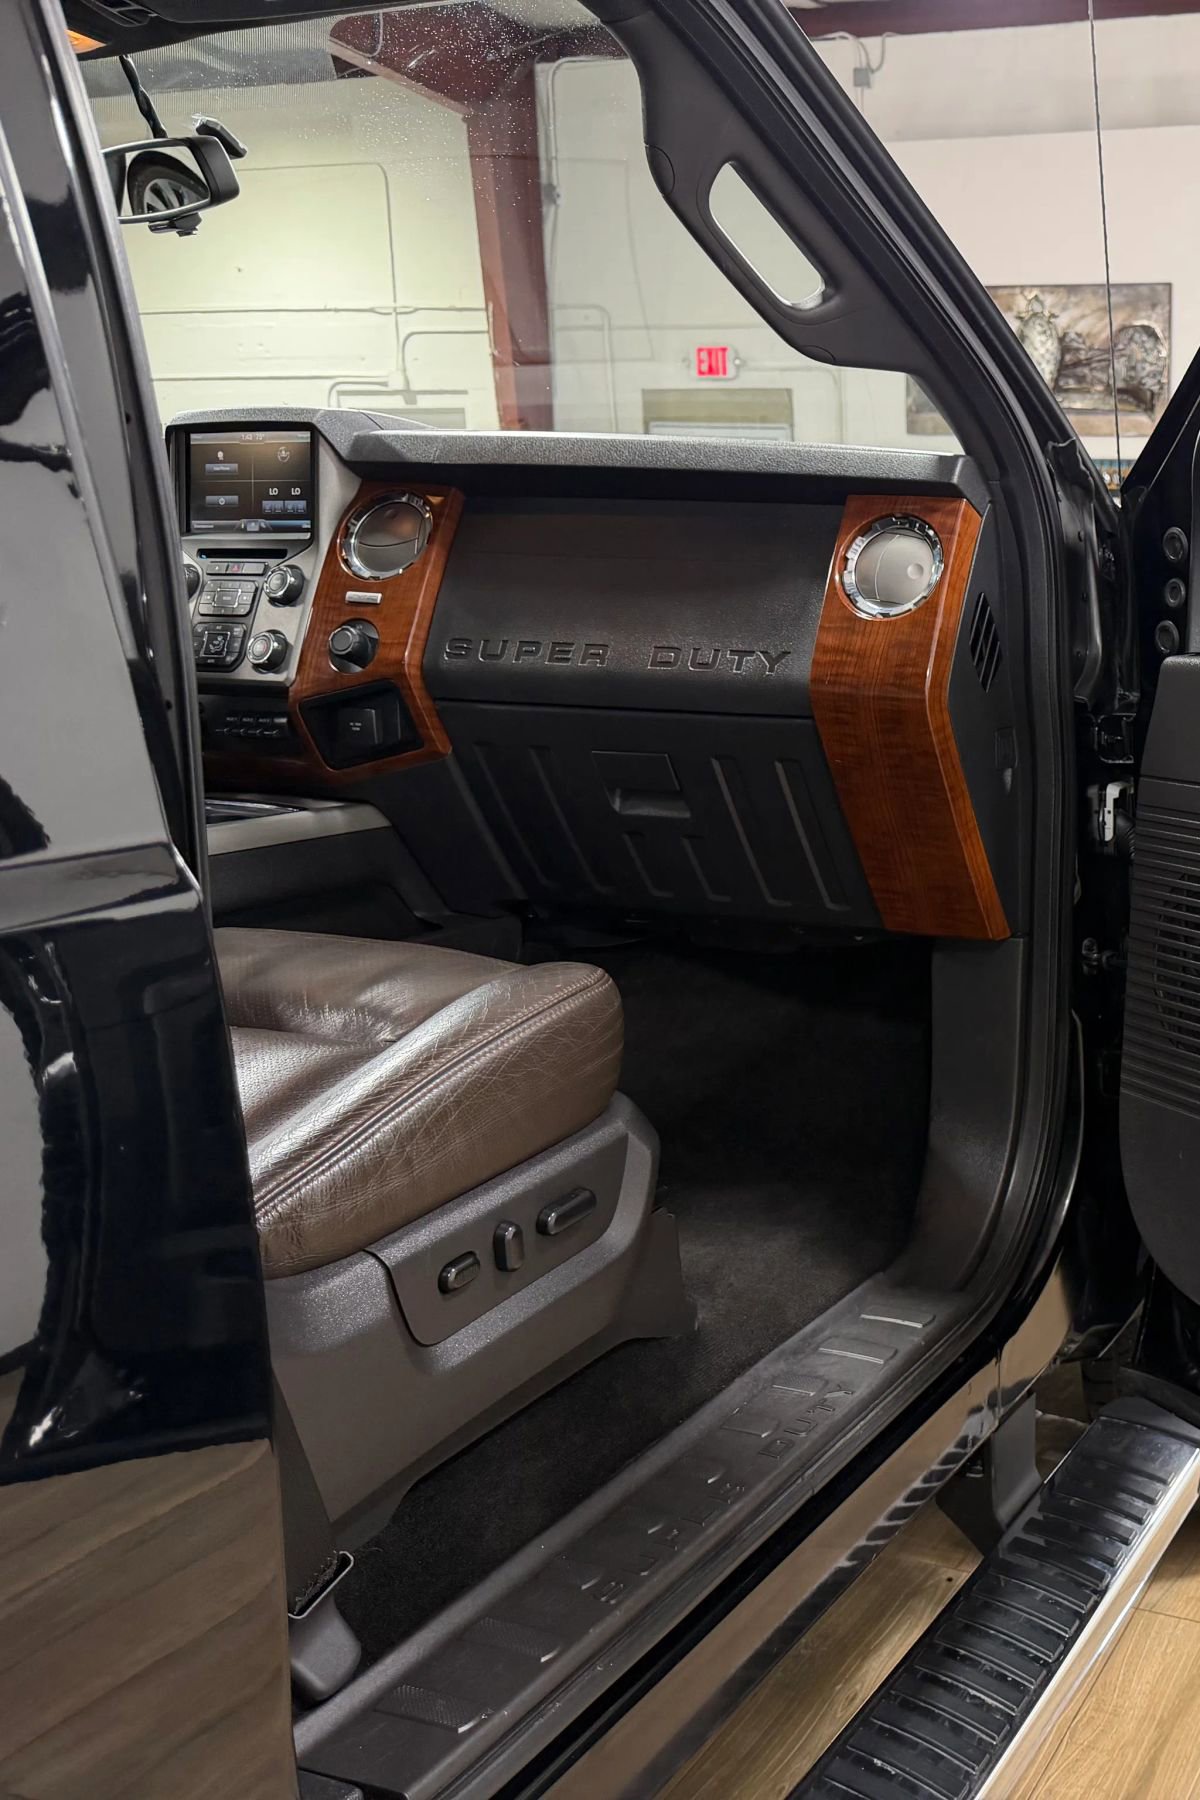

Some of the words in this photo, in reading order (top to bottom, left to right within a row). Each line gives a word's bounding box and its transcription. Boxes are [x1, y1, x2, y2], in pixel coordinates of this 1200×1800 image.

[697, 347, 728, 376] EXIT
[269, 487, 279, 495] LO
[291, 487, 301, 495] LO
[444, 638, 610, 667] SUPER
[648, 646, 791, 675] DUTY
